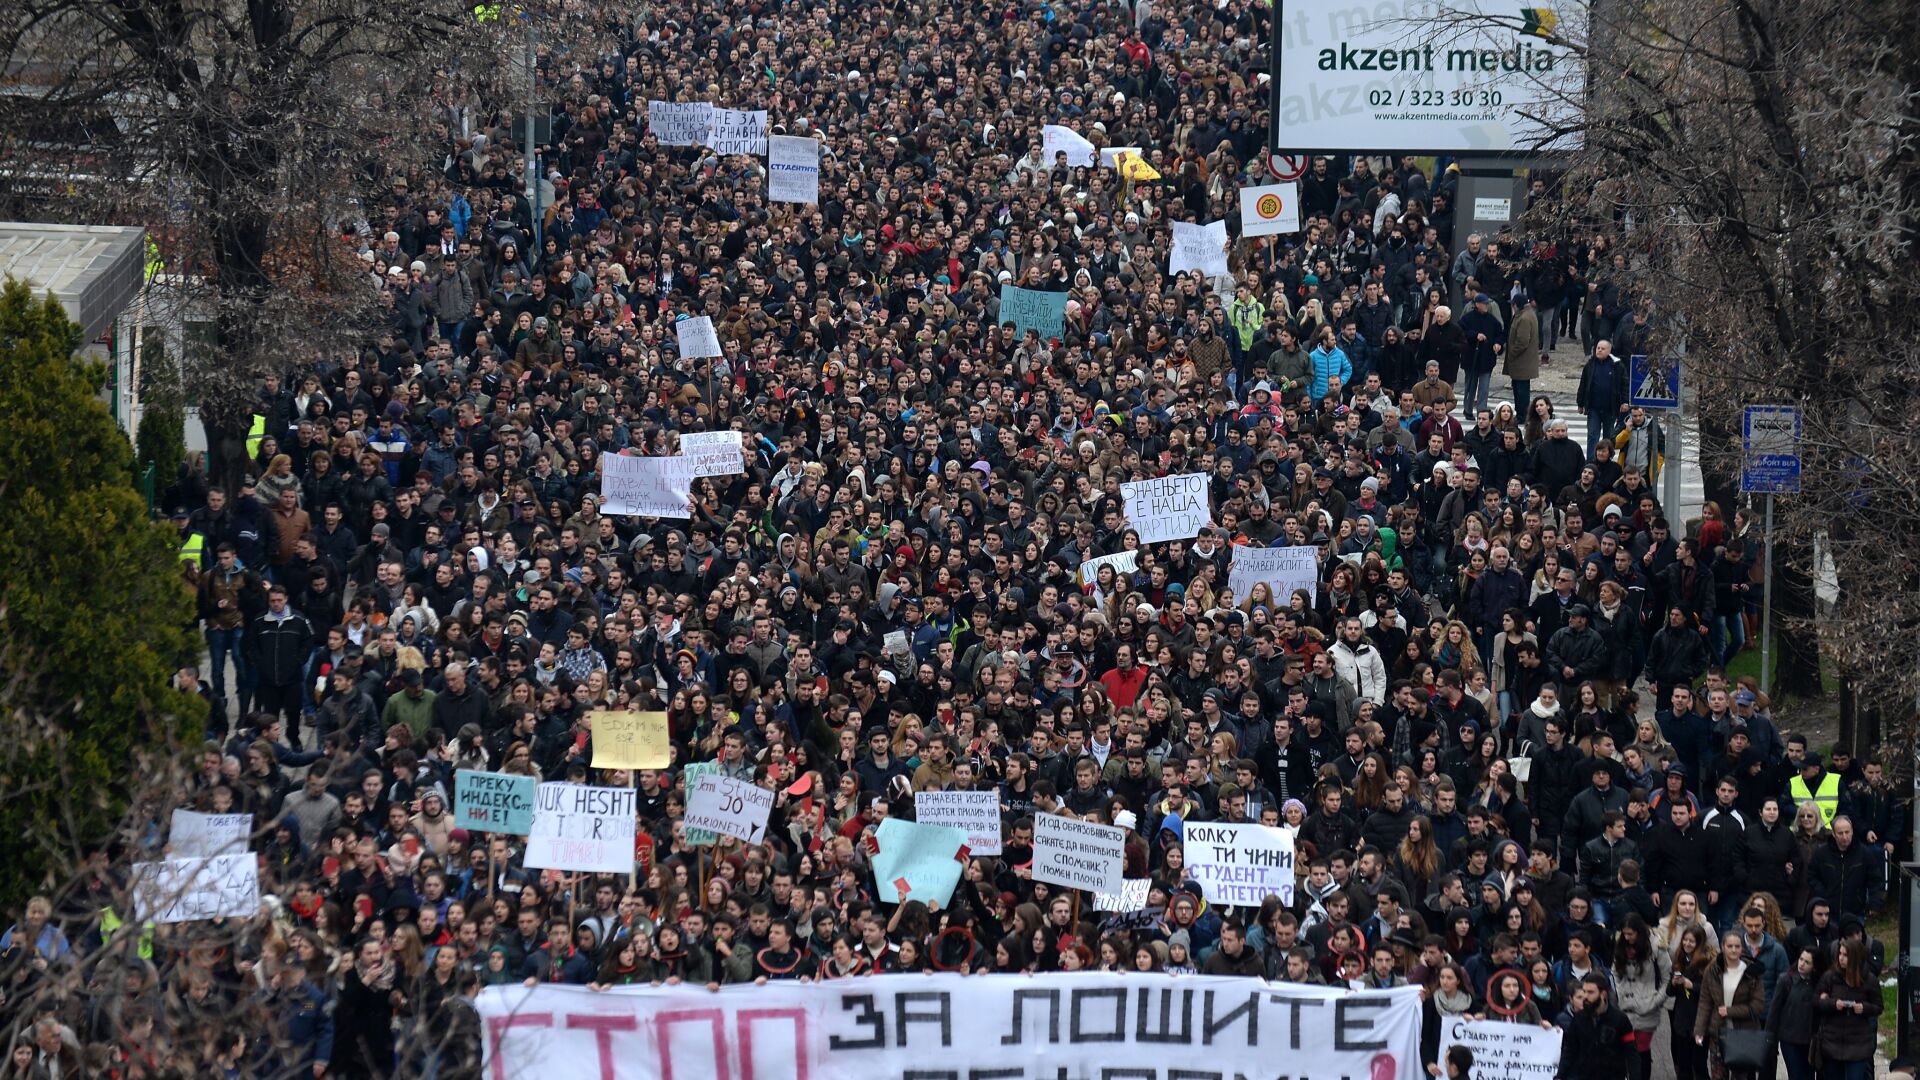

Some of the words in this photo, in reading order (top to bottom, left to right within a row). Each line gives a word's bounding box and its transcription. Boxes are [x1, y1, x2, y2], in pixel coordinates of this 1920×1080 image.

[1318, 42, 1433, 71] akzent
[1448, 42, 1553, 71] media
[1370, 90, 1391, 106] 02
[1410, 91, 1444, 106] 323
[1450, 91, 1473, 106] 30
[1479, 91, 1501, 106] 30
[739, 112, 757, 126] ЗА
[1374, 111, 1496, 121] www.akzentmedia.com.mk
[1122, 476, 1202, 500] ЗНАЕЊЕТО
[1137, 501, 1146, 517] Е
[1152, 495, 1202, 513] НАША
[1132, 517, 1204, 539] ПАРТИЈА
[1234, 547, 1247, 558] НЕ
[1251, 549, 1257, 558] Е
[1277, 560, 1302, 571] ИСПИТ
[469, 776, 515, 792] ПРЕКУ
[719, 777, 772, 809] Student
[534, 786, 568, 812] NUK
[574, 789, 635, 816] HESHT
[719, 794, 743, 815] JO
[918, 794, 962, 805] ДРЖАВЕН
[468, 808, 488, 821] НИ
[918, 808, 955, 819] ДОДАТЕН
[957, 807, 985, 817] ПРИЛИВ
[988, 808, 997, 817] НА
[1038, 815, 1047, 825] И
[1048, 818, 1061, 830] ОД
[685, 814, 746, 838] MARIONETA
[1187, 827, 1238, 844] КОЛКУ
[1035, 834, 1063, 850] САКАТЕ
[1066, 839, 1077, 852] ДА
[1079, 842, 1121, 859] НАПРАВИТЕ
[1212, 846, 1236, 863] ТИ
[1244, 848, 1292, 869] ЧИНИ
[1039, 864, 1071, 880] (ПОМЕН
[1073, 873, 1107, 889] ПЛОЧА)
[1189, 863, 1270, 883] СТУДЕНТ
[829, 992, 951, 1050] ЗА
[1001, 987, 1391, 1050] ЛОШИТЕ
